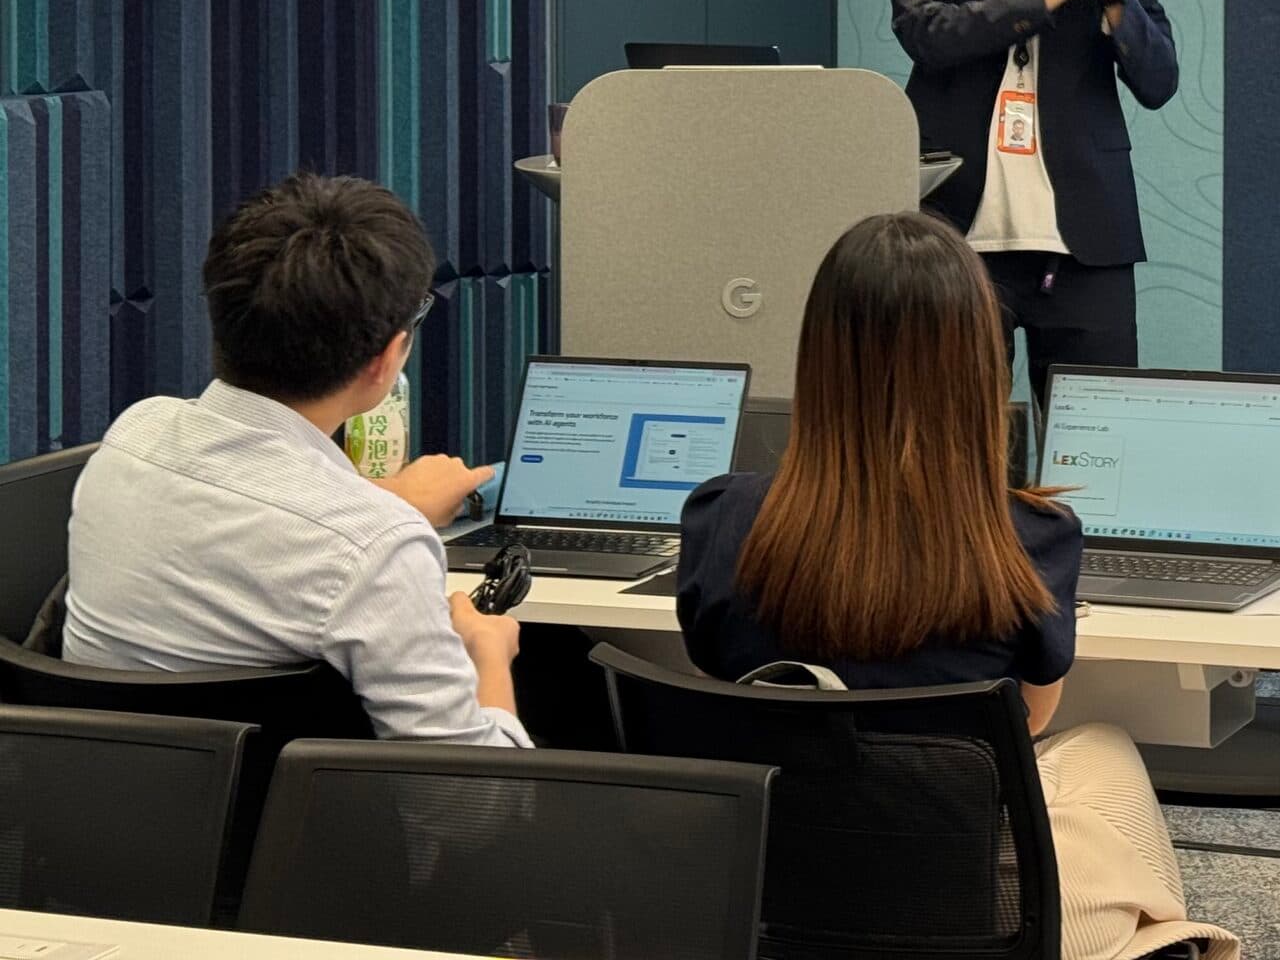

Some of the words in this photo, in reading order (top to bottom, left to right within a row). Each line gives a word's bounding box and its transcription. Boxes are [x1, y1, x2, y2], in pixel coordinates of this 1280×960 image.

[722, 277, 762, 319] G
[529, 409, 565, 419] Transform
[566, 412, 581, 420] your
[583, 412, 619, 421] workforce
